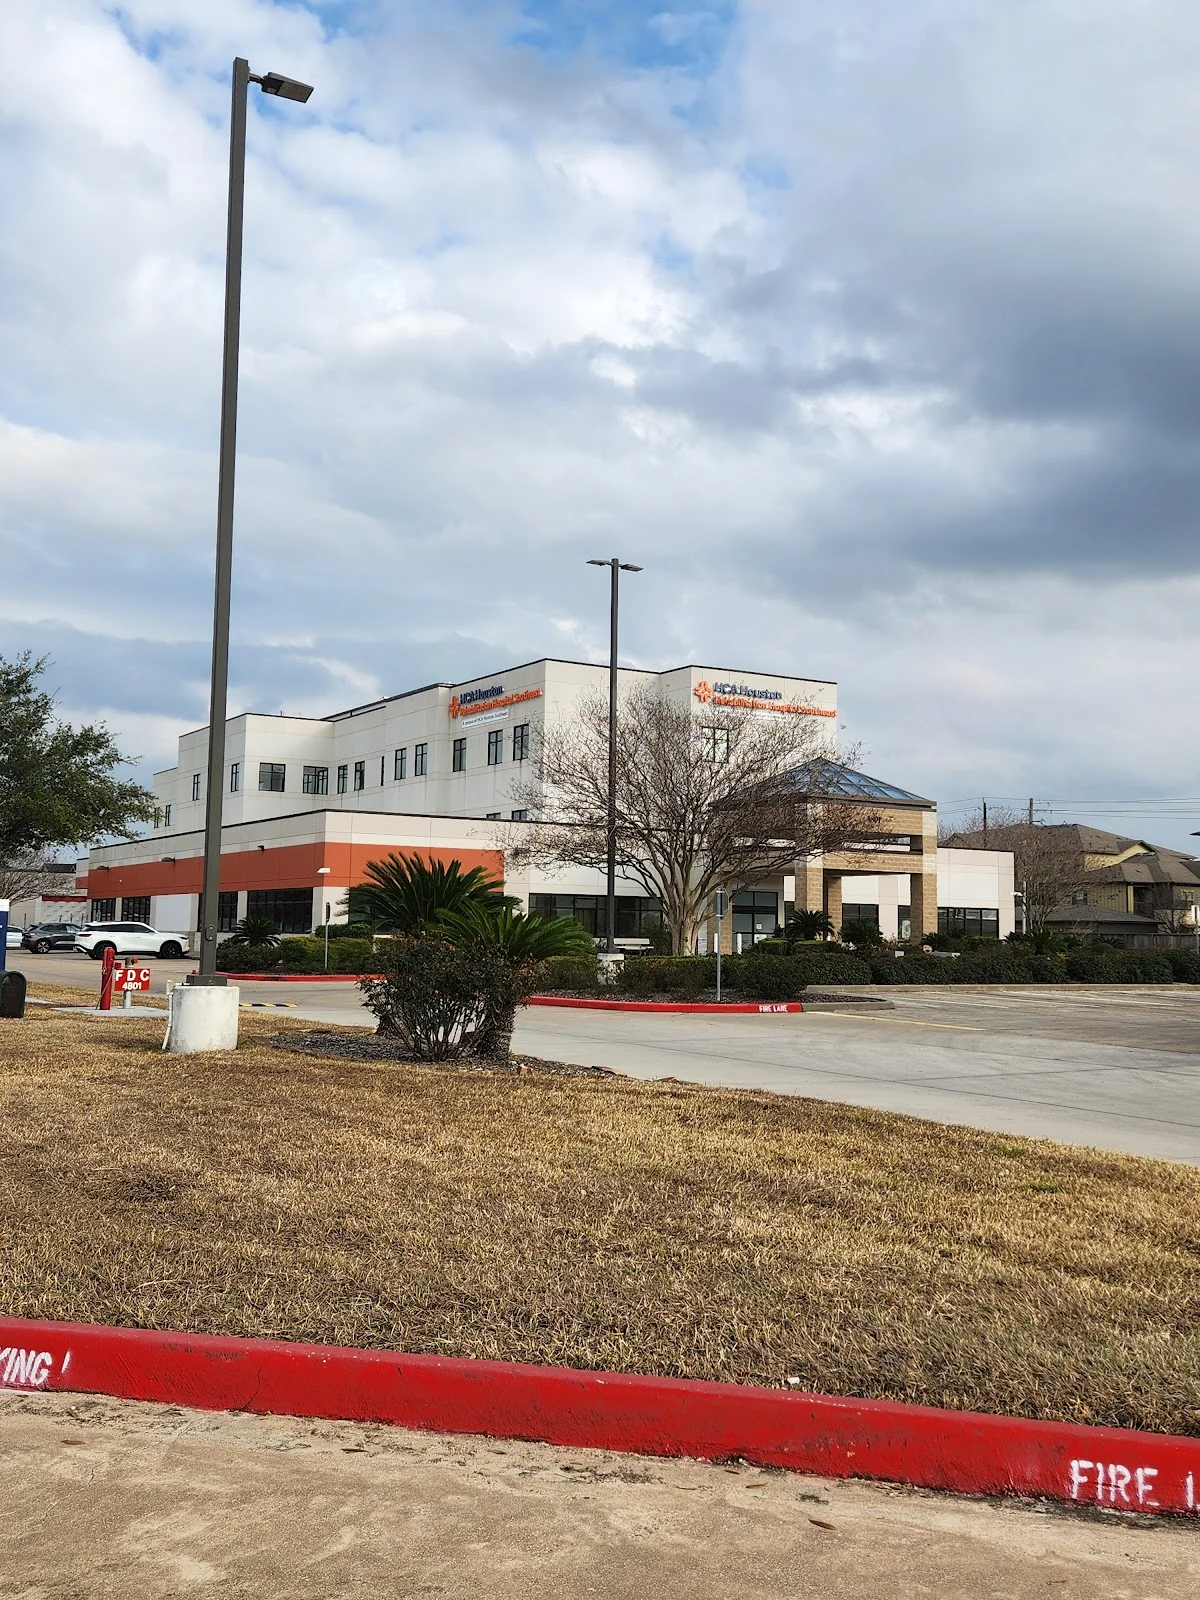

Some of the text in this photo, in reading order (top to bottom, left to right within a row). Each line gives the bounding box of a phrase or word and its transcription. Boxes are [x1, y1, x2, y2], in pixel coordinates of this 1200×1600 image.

[475, 685, 504, 700] Houston
[714, 682, 782, 700] HCA Houston
[122, 982, 142, 990] 4801
[759, 1004, 788, 1012] FIRE LANE
[1070, 1459, 1160, 1507] FIRE
